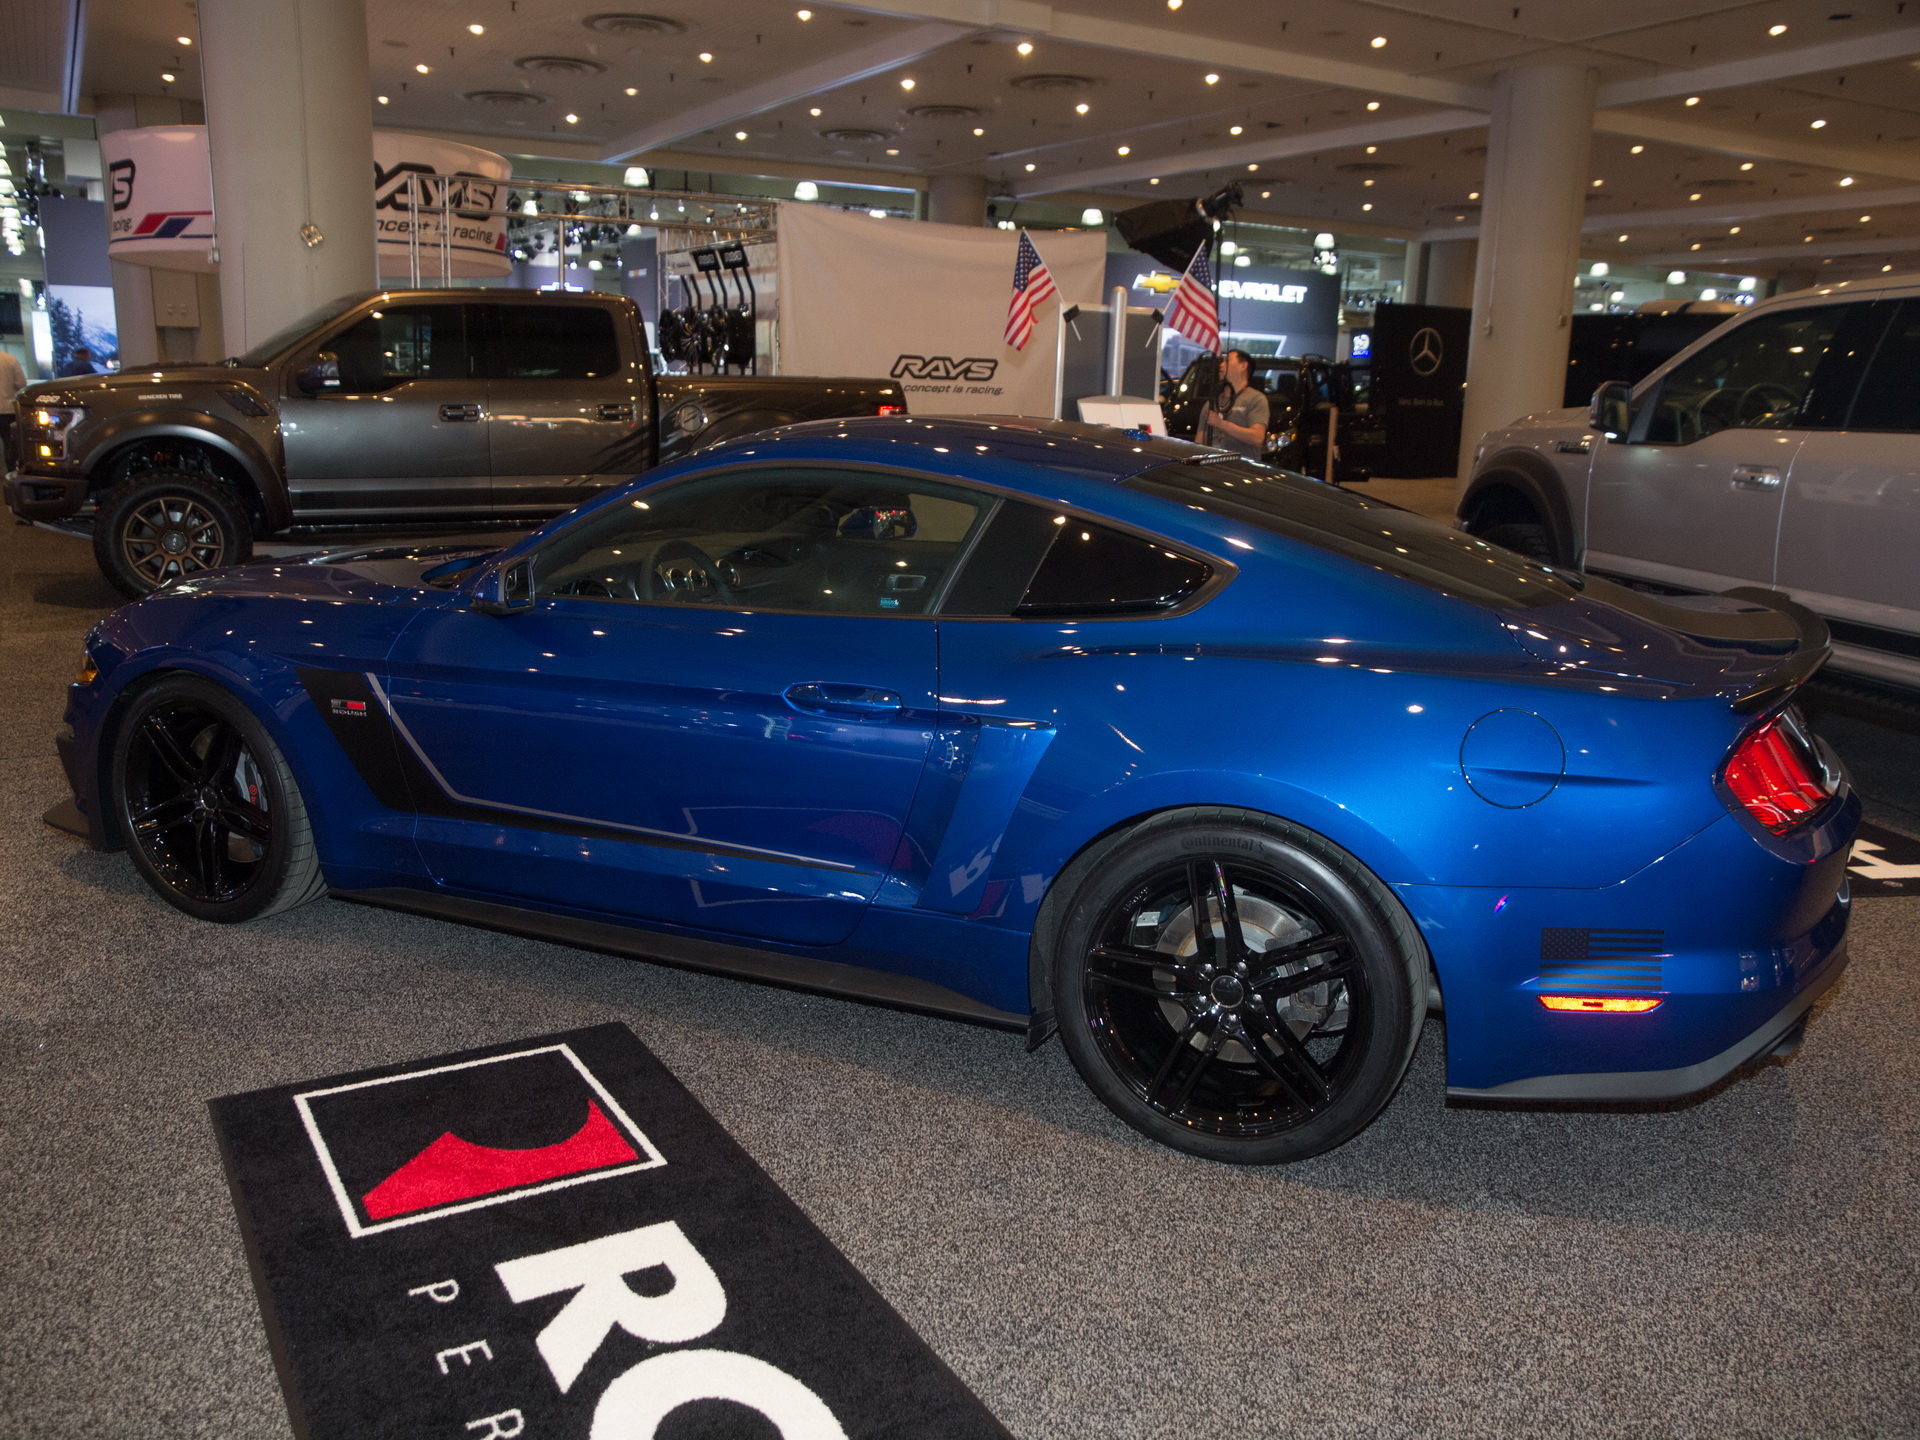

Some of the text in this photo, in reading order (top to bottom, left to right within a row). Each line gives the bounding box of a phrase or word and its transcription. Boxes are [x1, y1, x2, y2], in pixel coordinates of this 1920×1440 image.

[889, 354, 998, 381] RAYS
[903, 384, 1004, 396] concept is racing.
